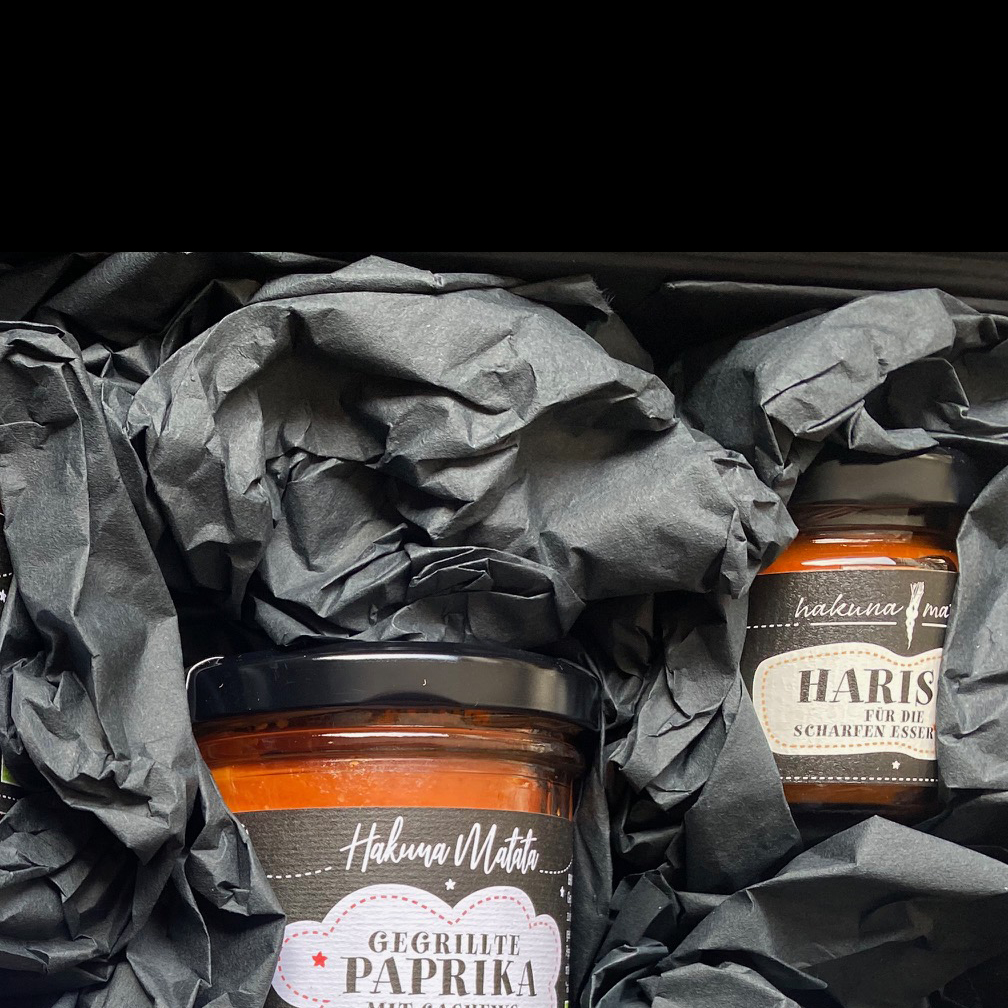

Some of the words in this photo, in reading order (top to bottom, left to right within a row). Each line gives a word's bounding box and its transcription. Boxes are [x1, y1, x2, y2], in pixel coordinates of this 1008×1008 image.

[794, 594, 904, 618] hakuna
[921, 602, 952, 619] ma
[797, 667, 935, 707] HARIS
[864, 707, 896, 723] FÜR
[900, 709, 925, 724] DIE
[793, 724, 886, 738] SCHARFEN
[890, 725, 934, 740] ESSER
[339, 816, 451, 873] Hakuna
[454, 822, 540, 875] Matata
[368, 930, 520, 957] GEGRILLTE
[339, 956, 538, 998] PAPRIKA
